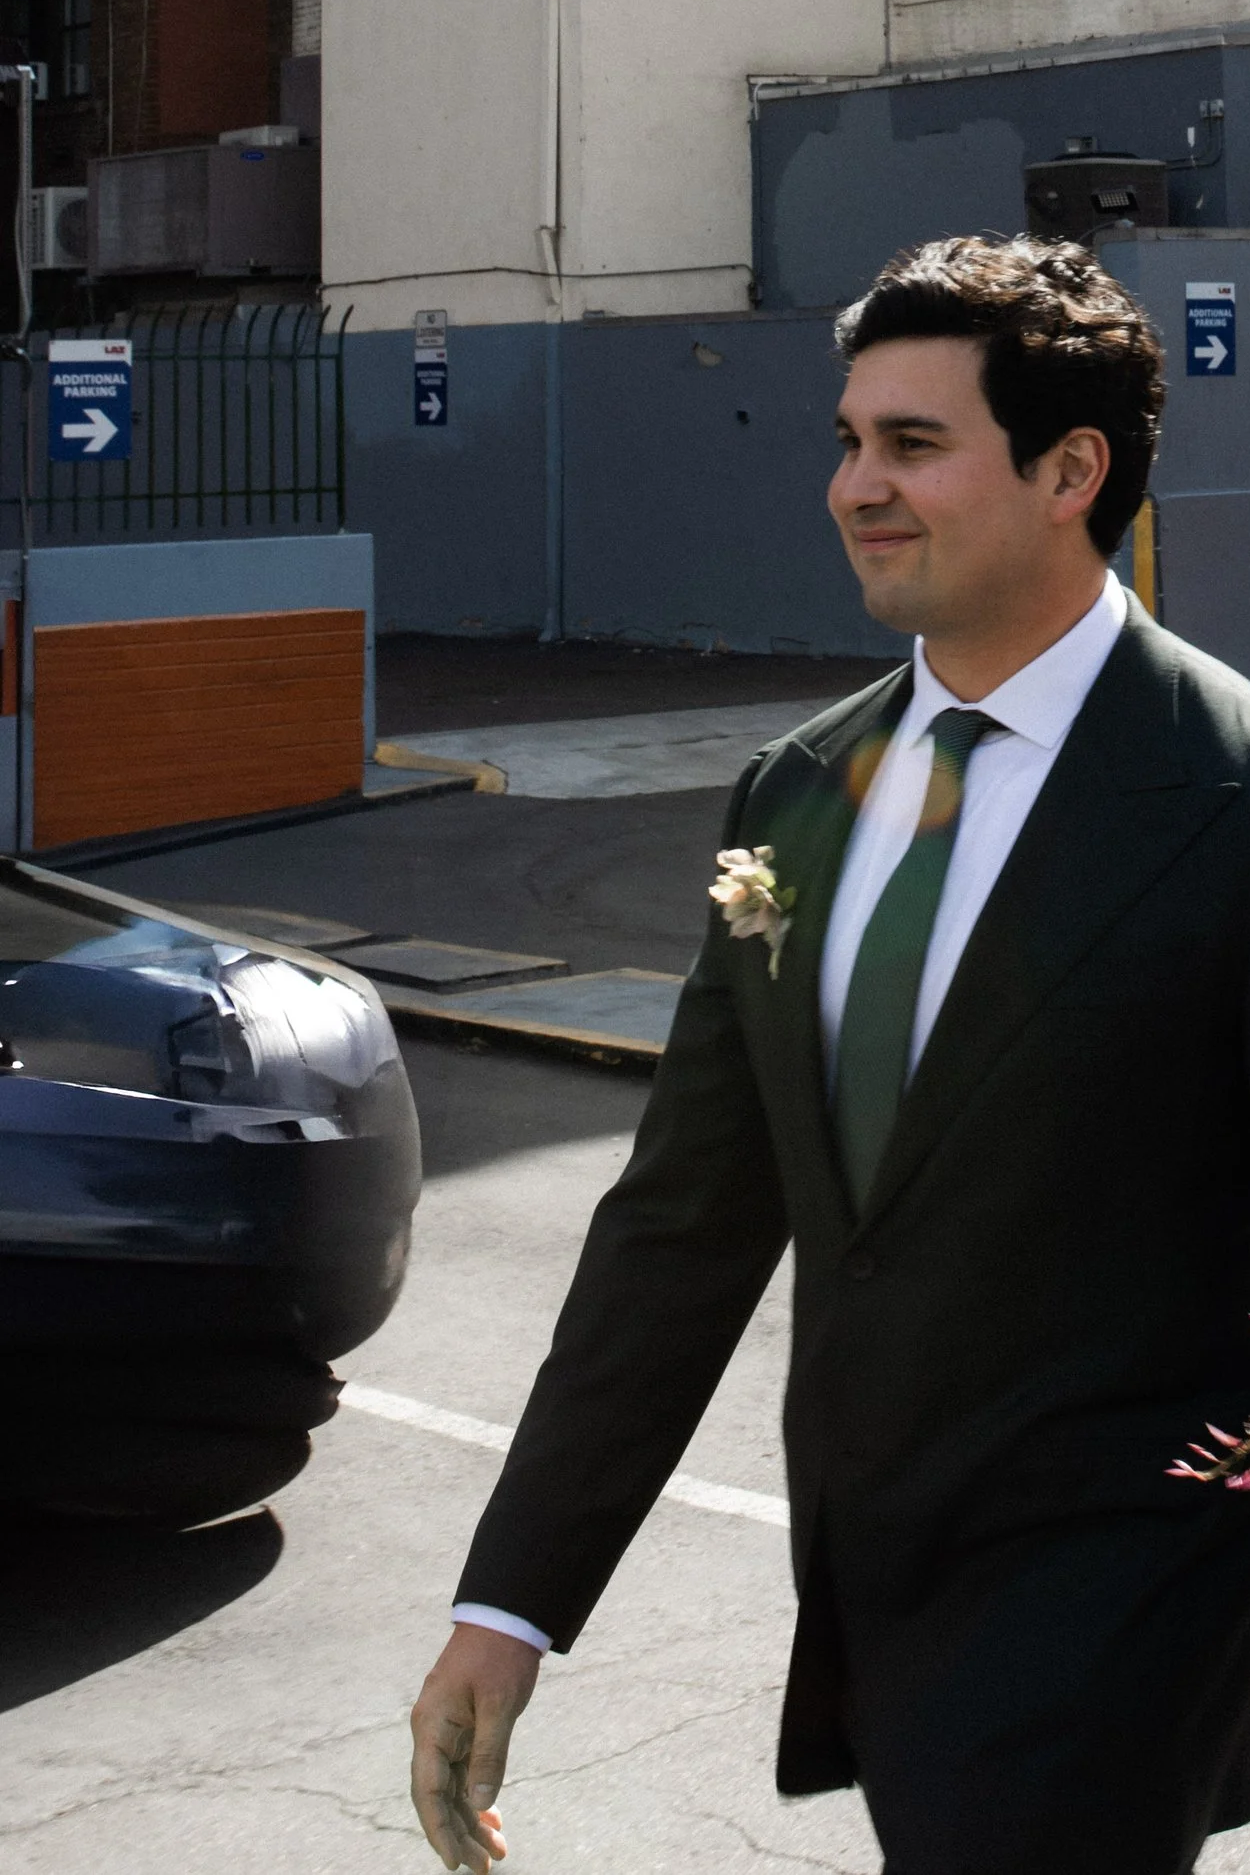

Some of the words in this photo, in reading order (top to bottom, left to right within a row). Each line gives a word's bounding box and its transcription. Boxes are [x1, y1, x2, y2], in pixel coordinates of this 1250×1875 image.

[1188, 308, 1233, 317] ADDITIONAL
[1195, 318, 1227, 327] PARKING
[104, 345, 126, 354] LAZ
[53, 374, 127, 385] ADDITIONAL
[63, 386, 117, 398] PARKING
